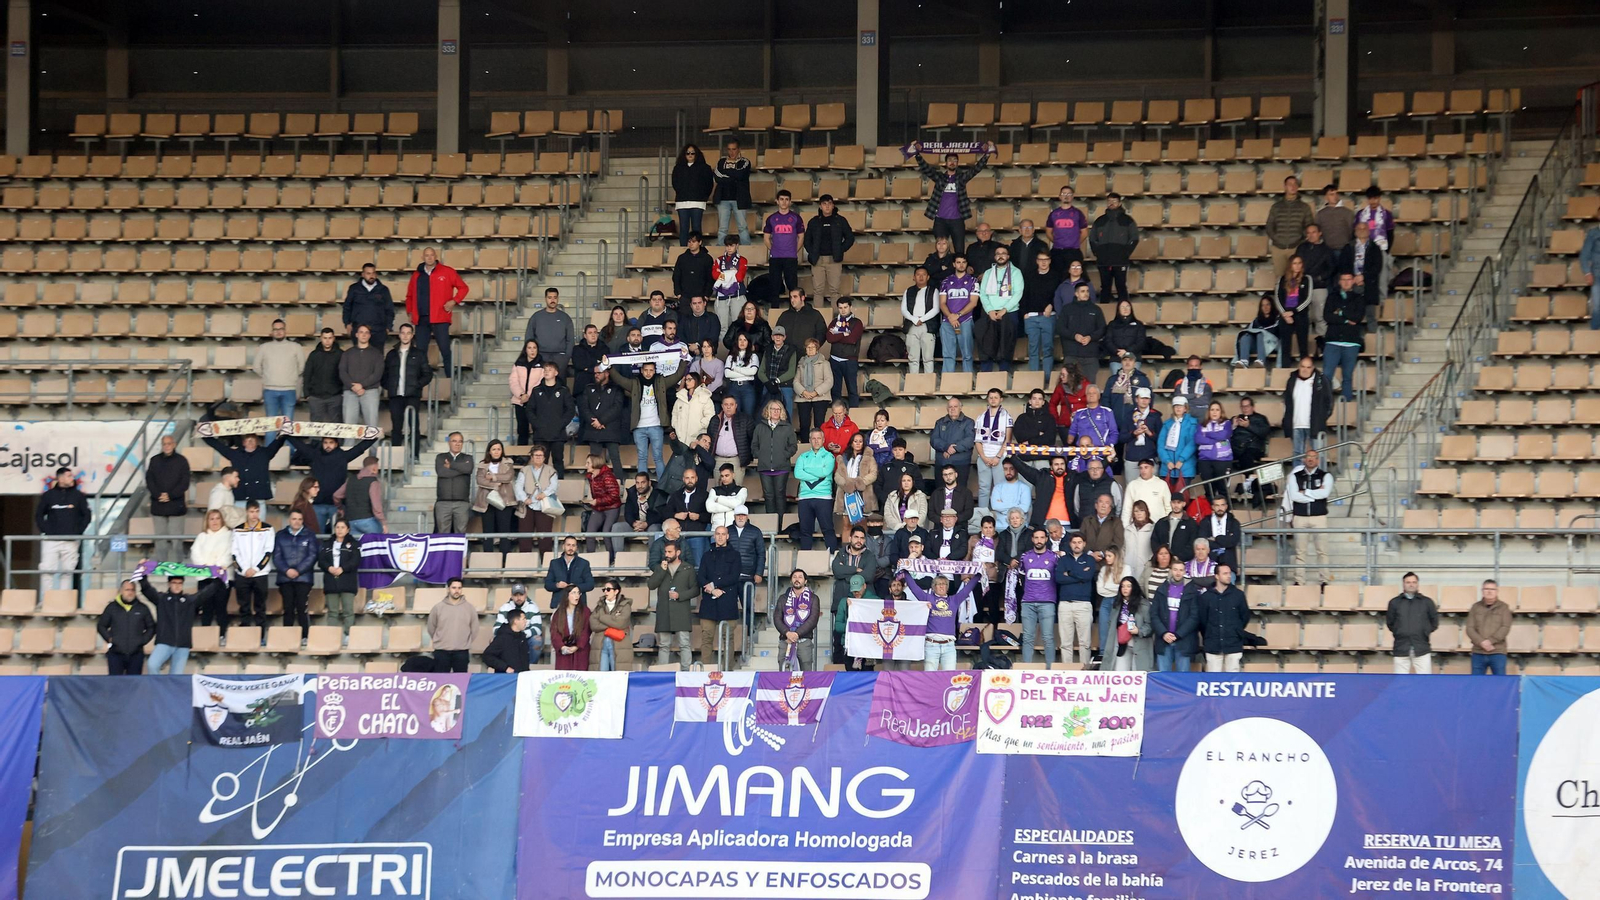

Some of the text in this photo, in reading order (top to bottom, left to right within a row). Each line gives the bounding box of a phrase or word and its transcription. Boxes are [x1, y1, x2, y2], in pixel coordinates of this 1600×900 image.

[861, 36, 875, 44] 331
[442, 45, 456, 53] 332
[923, 141, 945, 149] REAL
[1009, 443, 1111, 456] 1922 2022
[1021, 673, 1143, 685] Peña AMIGOS
[1020, 689, 1047, 700] DEL
[1196, 681, 1336, 698] RESTAURANTE
[381, 693, 401, 710] EL
[358, 713, 420, 735] CHATO
[1020, 715, 1136, 730] 1922 2019
[219, 732, 270, 745] REAL JAÉN
[979, 727, 1001, 742] Mas
[1004, 737, 1019, 749] que
[1091, 740, 1106, 749] una
[1110, 731, 1139, 751] pasión
[1206, 751, 1310, 762] EL RANCHO
[607, 764, 916, 819] JIMANG
[603, 829, 913, 852] Empresa Aplicadora Homologada
[1014, 829, 1134, 843] ESPECIALIDADES
[1364, 834, 1502, 849] RESERVA TU MESA
[1013, 850, 1138, 865] Carnes a la brasa
[1228, 846, 1279, 860] JEREZ
[1344, 856, 1503, 873] Avenida de Arcos, 74
[124, 853, 423, 898] JMELECTRI
[595, 871, 922, 890] MONOCAPAS Y ENFOSCADOS
[1012, 872, 1164, 887] Pescados de la bahía
[1350, 878, 1502, 893] Jerez de la Frontera
